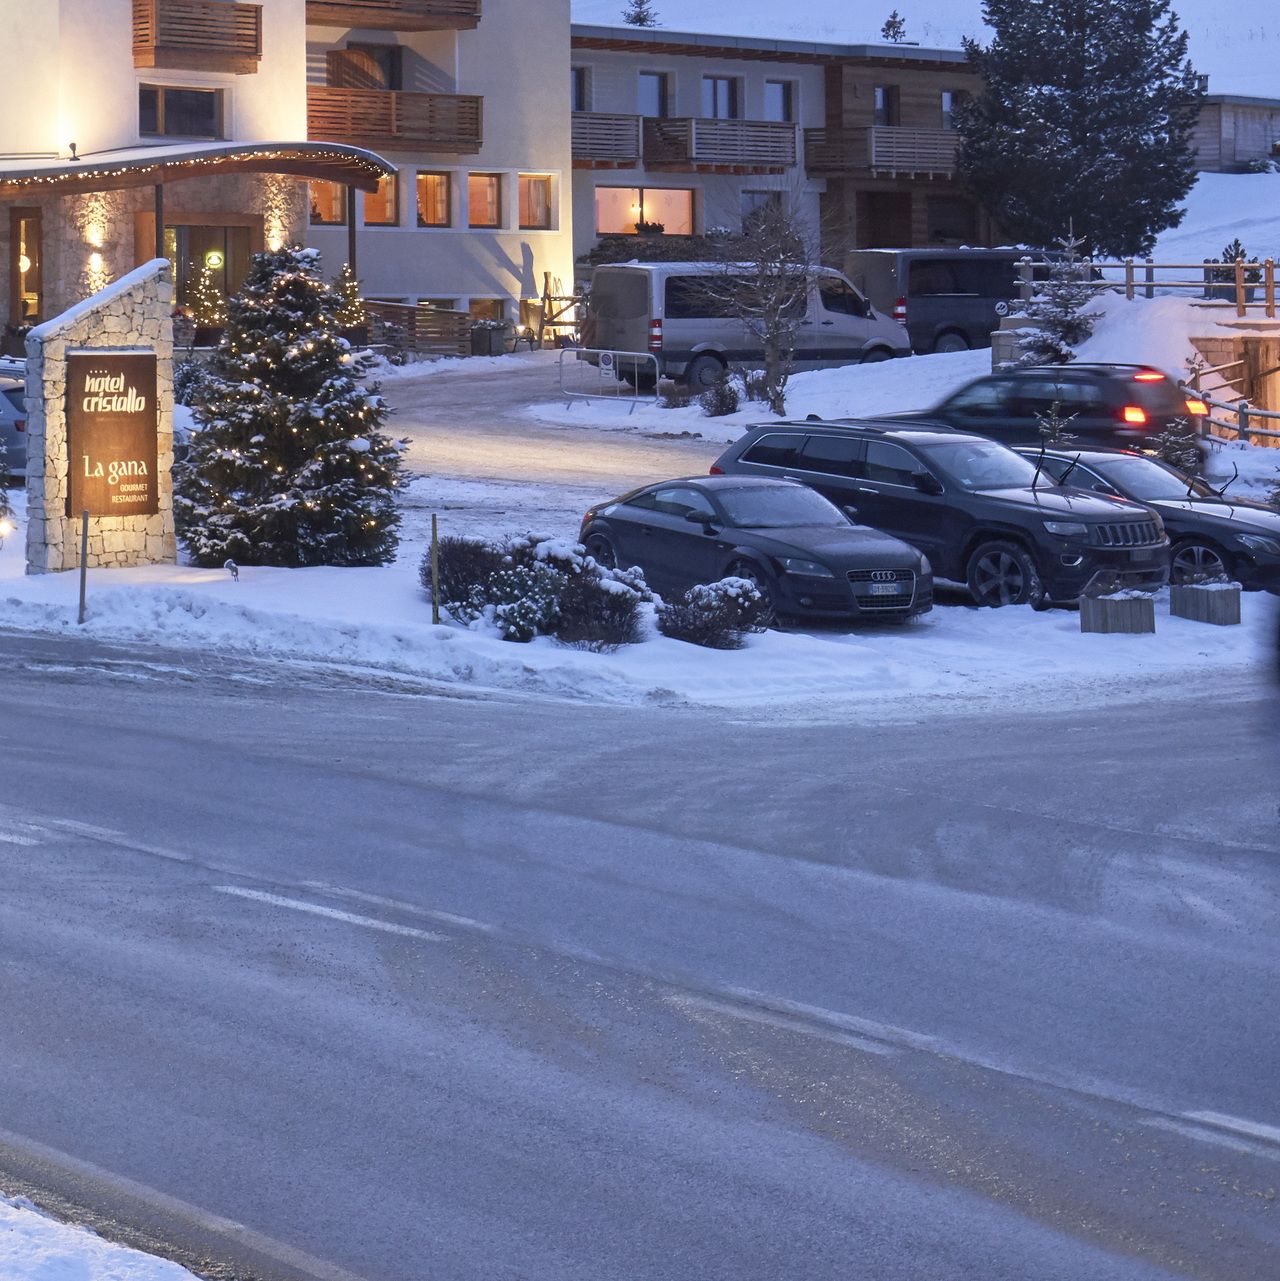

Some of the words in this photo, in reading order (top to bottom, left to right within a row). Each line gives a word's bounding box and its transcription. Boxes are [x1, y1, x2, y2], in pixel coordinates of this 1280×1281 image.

[84, 372, 125, 393] hotel
[83, 385, 146, 414] cristallo
[82, 455, 105, 477] La
[107, 460, 148, 485] gana
[119, 483, 148, 493] GOURMET
[111, 494, 148, 504] RESTAURANT
